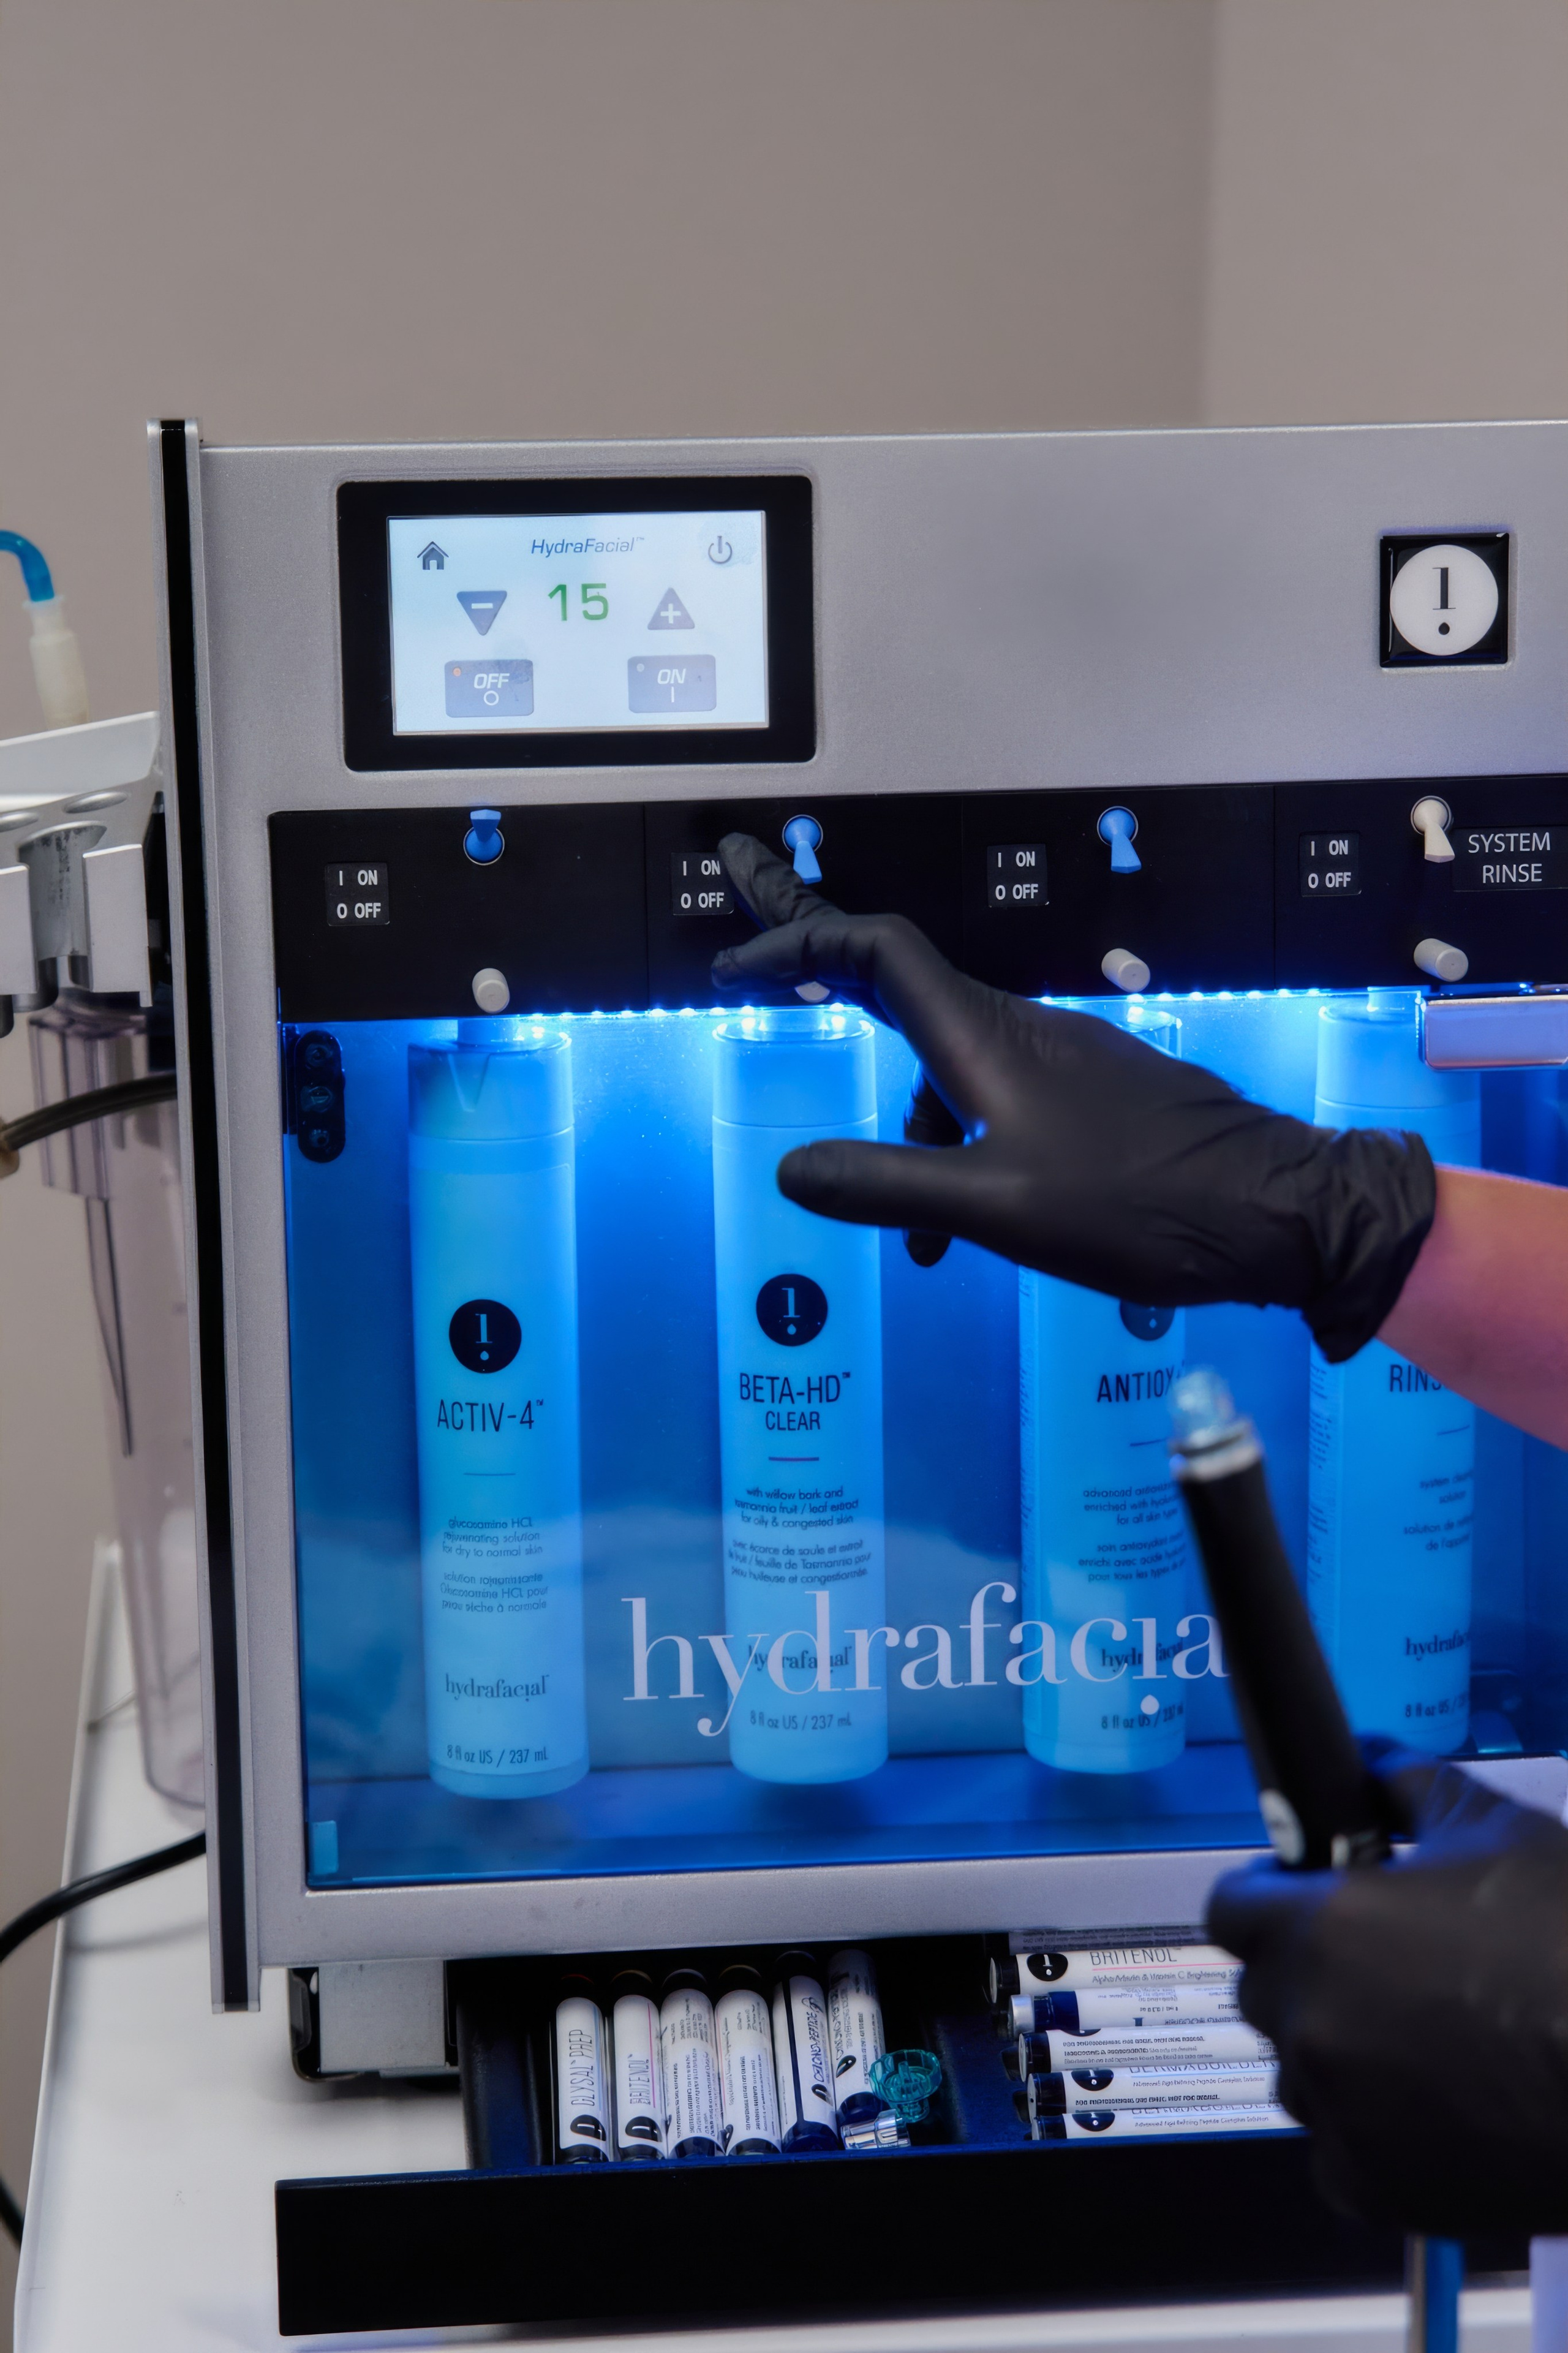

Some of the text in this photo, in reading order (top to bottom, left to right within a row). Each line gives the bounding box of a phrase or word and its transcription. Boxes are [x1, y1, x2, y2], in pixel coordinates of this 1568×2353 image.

[548, 583, 609, 622] 15
[473, 673, 510, 689] OFF
[657, 668, 686, 685] ON
[1329, 840, 1349, 855] ON
[1468, 832, 1551, 853] SYSTEM
[1016, 851, 1035, 867] ON
[701, 860, 721, 875] ON
[1482, 863, 1543, 884] RINSE
[358, 870, 378, 886] ON
[1325, 872, 1351, 888] OFF
[1012, 883, 1038, 899] OFF
[698, 892, 724, 908] OFF
[355, 902, 381, 918] OFF
[765, 1410, 821, 1431] CLEAR
[799, 1489, 821, 1500] bark
[620, 1581, 1231, 1737] hydrafacia
[767, 1718, 779, 1729] oz
[782, 1715, 798, 1730] US
[801, 1715, 808, 1731] /
[811, 1714, 834, 1731] 237
[447, 1745, 453, 1759] 8
[464, 1752, 475, 1763] oz
[479, 1749, 493, 1764] US
[496, 1749, 505, 1769] /
[509, 1748, 530, 1764] 237
